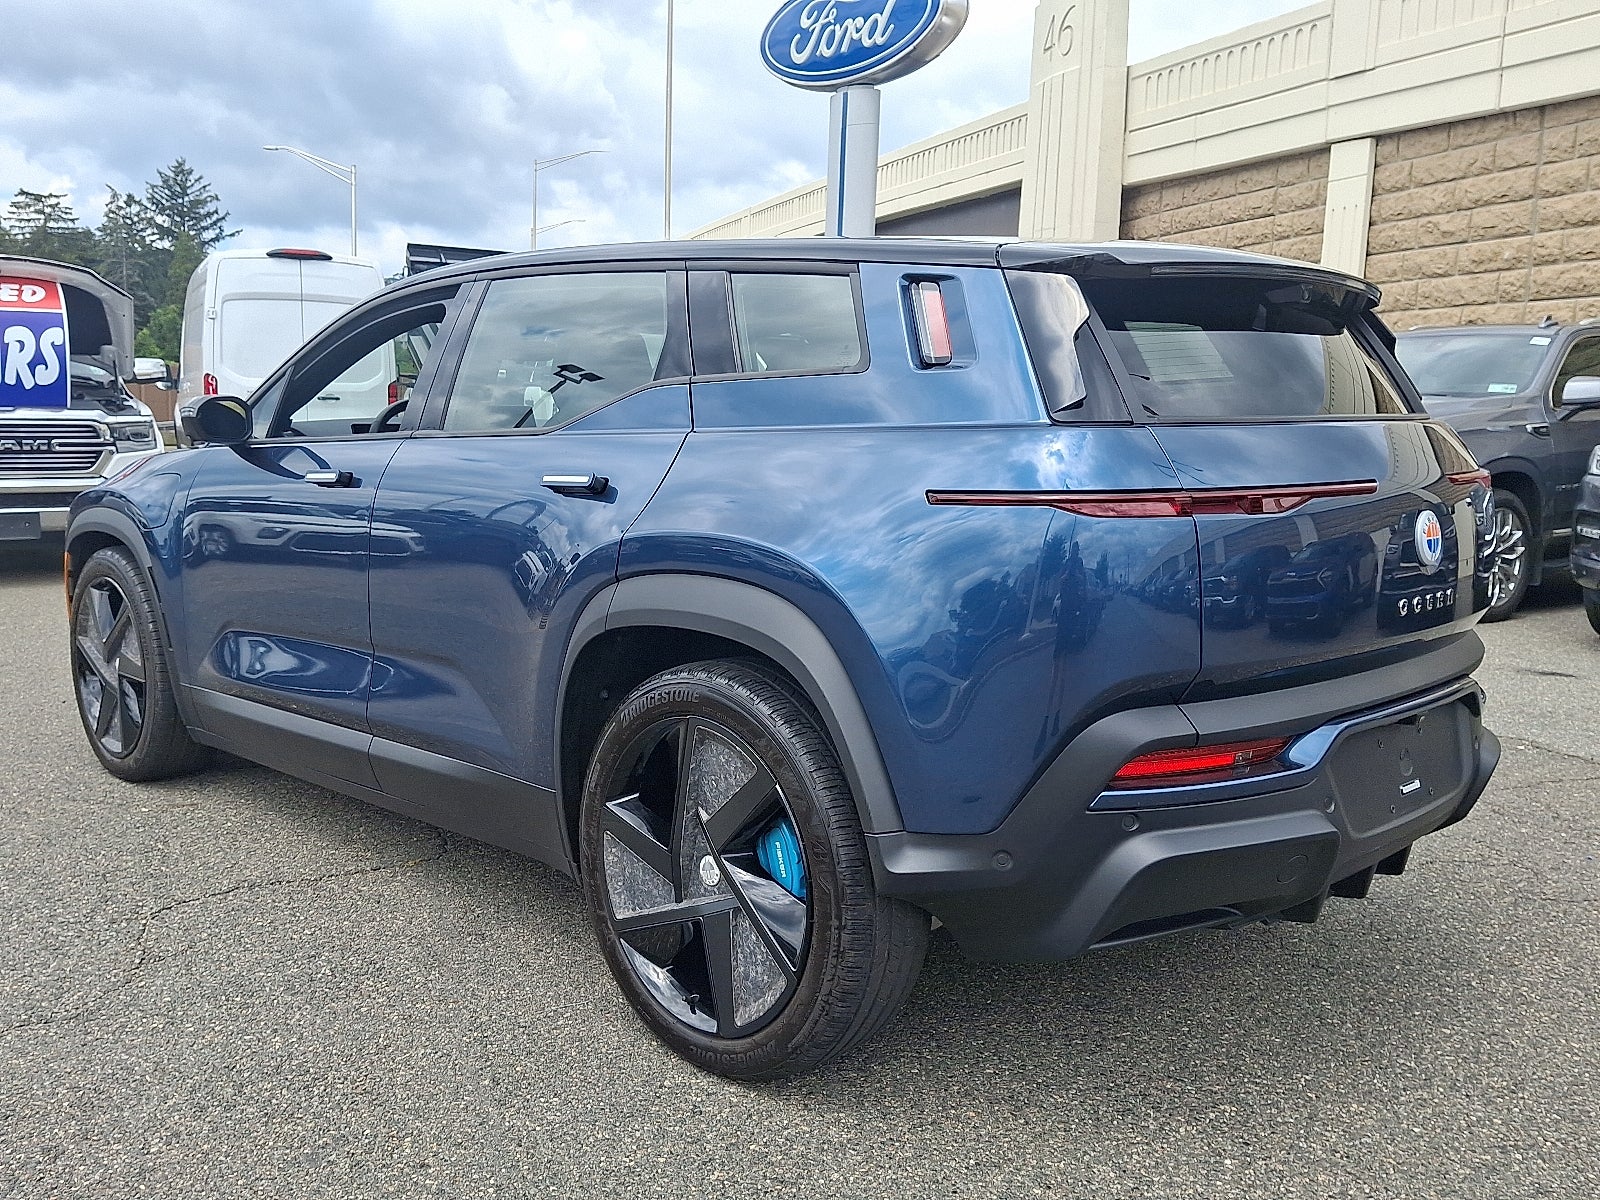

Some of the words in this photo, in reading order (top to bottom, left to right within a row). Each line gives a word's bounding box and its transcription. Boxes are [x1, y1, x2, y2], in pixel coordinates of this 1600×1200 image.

[790, 0, 896, 65] Ford
[1043, 4, 1076, 62] 46
[0, 325, 64, 390] RS
[620, 686, 700, 728] BRIDGESTONE
